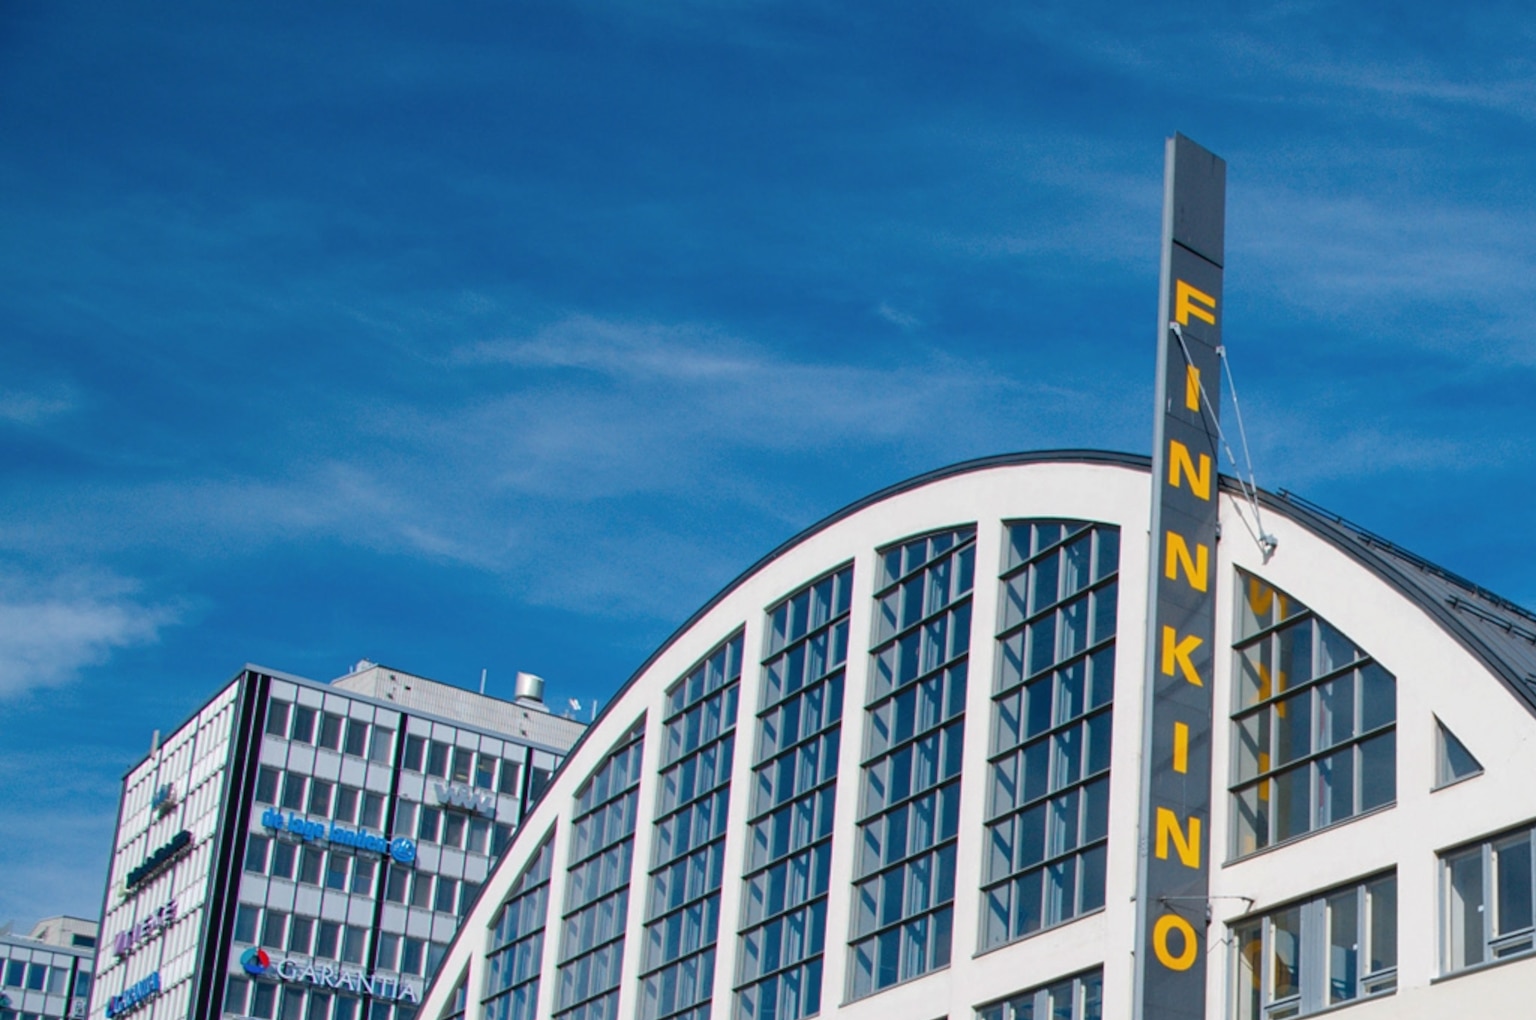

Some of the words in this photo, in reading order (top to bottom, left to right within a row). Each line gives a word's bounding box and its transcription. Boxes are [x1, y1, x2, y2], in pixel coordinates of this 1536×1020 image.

[1153, 279, 1216, 972] FINNKINO
[261, 807, 284, 830] de
[288, 811, 325, 842] lage
[329, 822, 388, 854] landen
[276, 958, 420, 1003] GARANTIA
